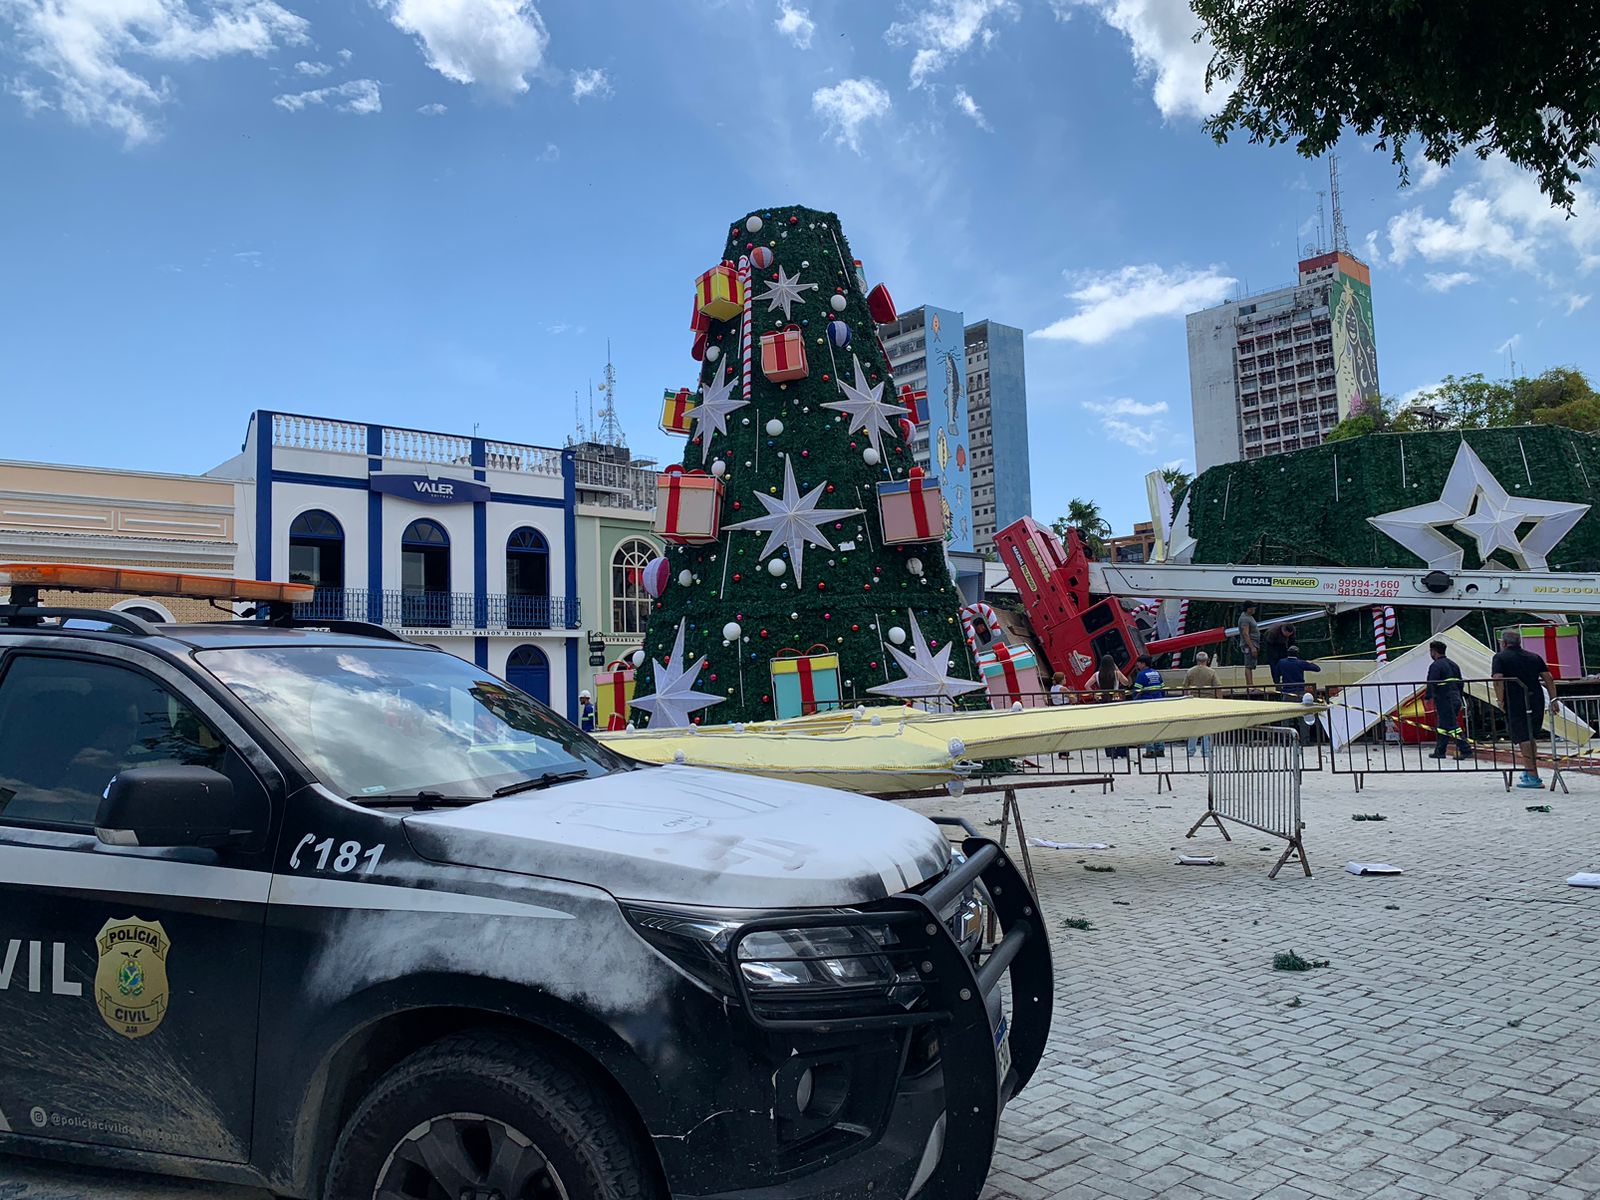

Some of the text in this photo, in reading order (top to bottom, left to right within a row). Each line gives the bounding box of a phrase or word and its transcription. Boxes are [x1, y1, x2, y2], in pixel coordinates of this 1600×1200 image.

[413, 481, 454, 495] VALER
[1236, 577, 1316, 586] MADAL PALFINGER
[1323, 578, 1400, 590] (92) 99994-1660
[1337, 587, 1400, 598] 98199-2467
[314, 837, 385, 874] 181
[109, 928, 158, 948] POLÍCIA
[115, 1008, 150, 1022] CIVIL
[125, 1026, 138, 1034] AM
